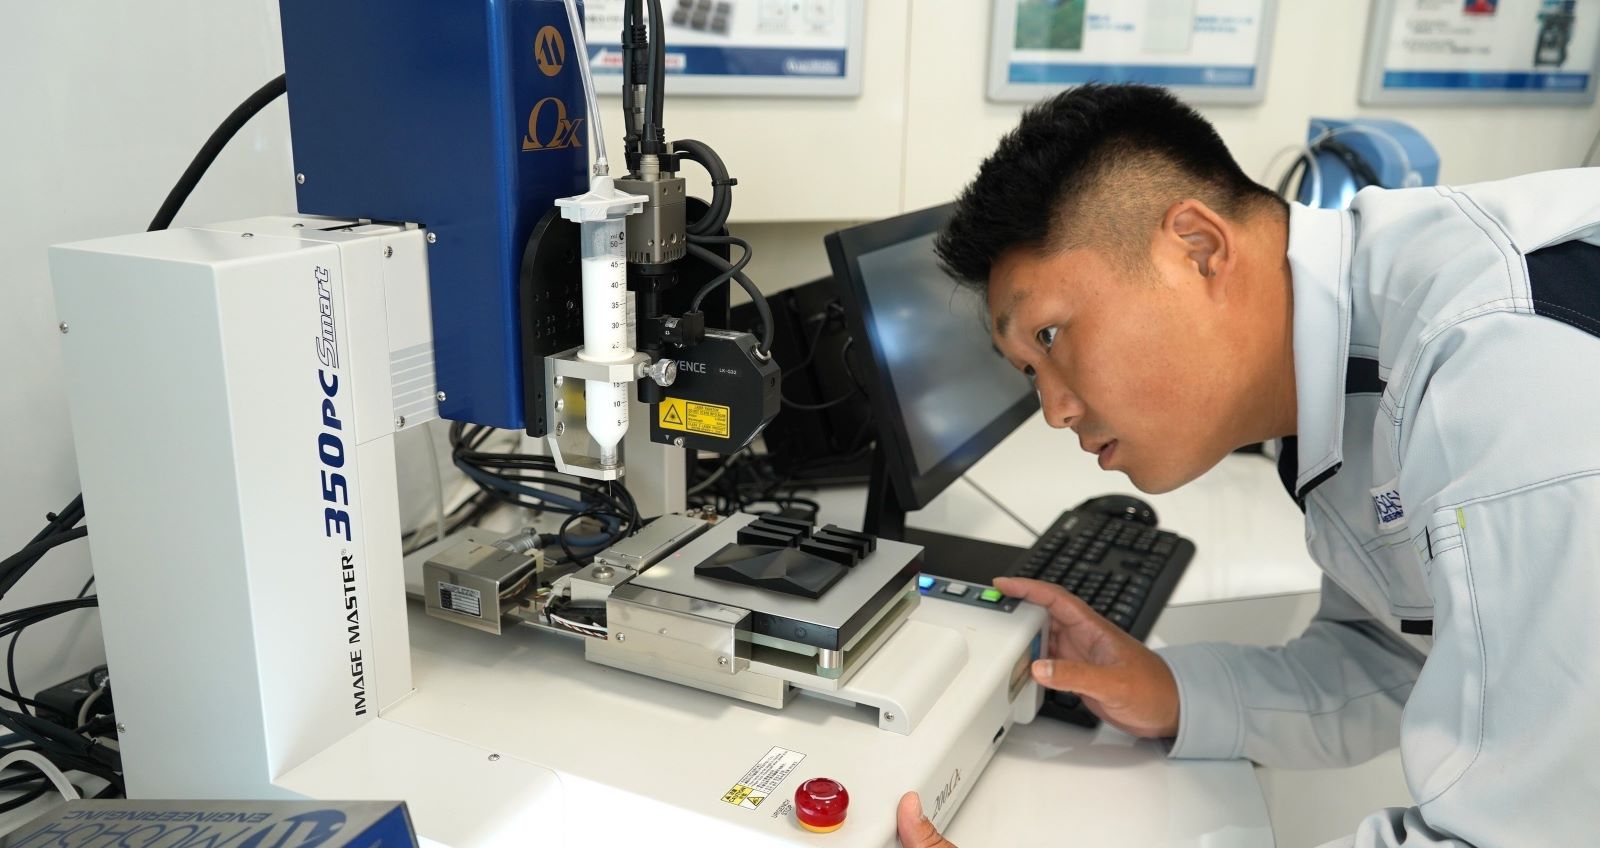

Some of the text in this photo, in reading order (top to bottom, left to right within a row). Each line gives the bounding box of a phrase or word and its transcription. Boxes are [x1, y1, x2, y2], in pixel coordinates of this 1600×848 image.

[315, 266, 338, 369] Smart
[610, 281, 619, 289] 40
[350, 649, 367, 716] IMAGE
